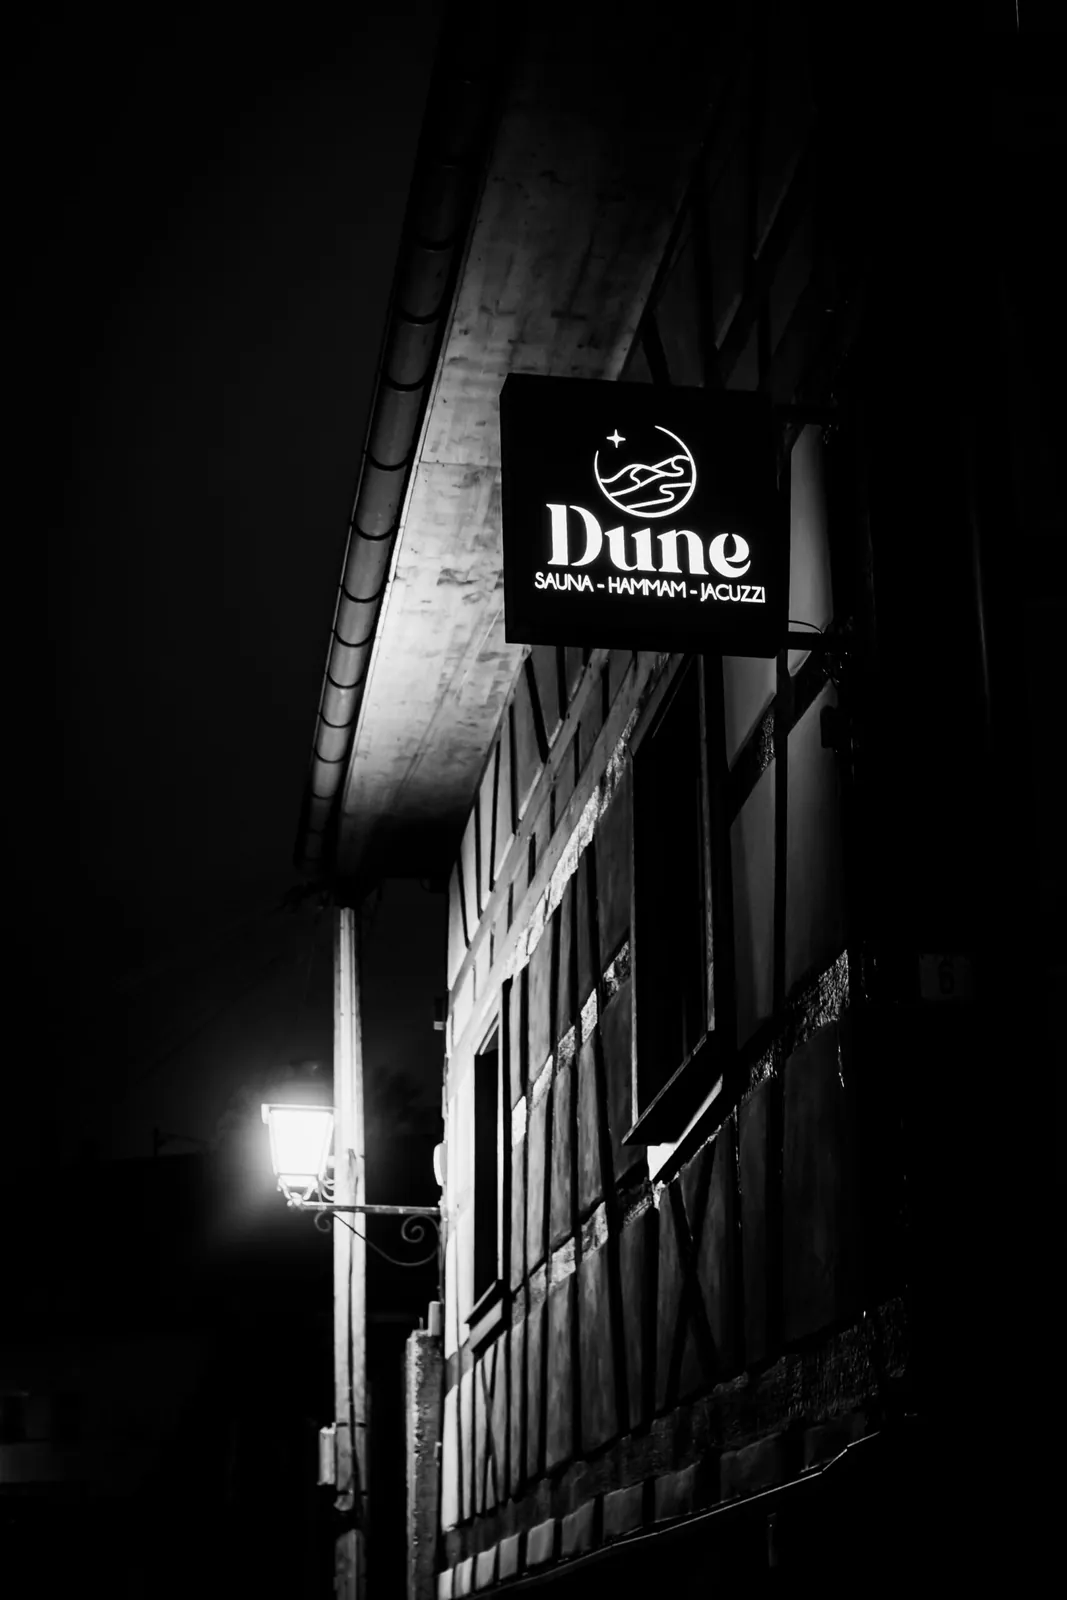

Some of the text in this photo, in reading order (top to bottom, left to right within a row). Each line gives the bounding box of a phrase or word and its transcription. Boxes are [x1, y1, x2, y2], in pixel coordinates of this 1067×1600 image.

[546, 503, 752, 579] Dune
[534, 571, 595, 593] SAUNA
[607, 575, 687, 599] HAMMAM
[699, 582, 766, 604] JACUZZI
